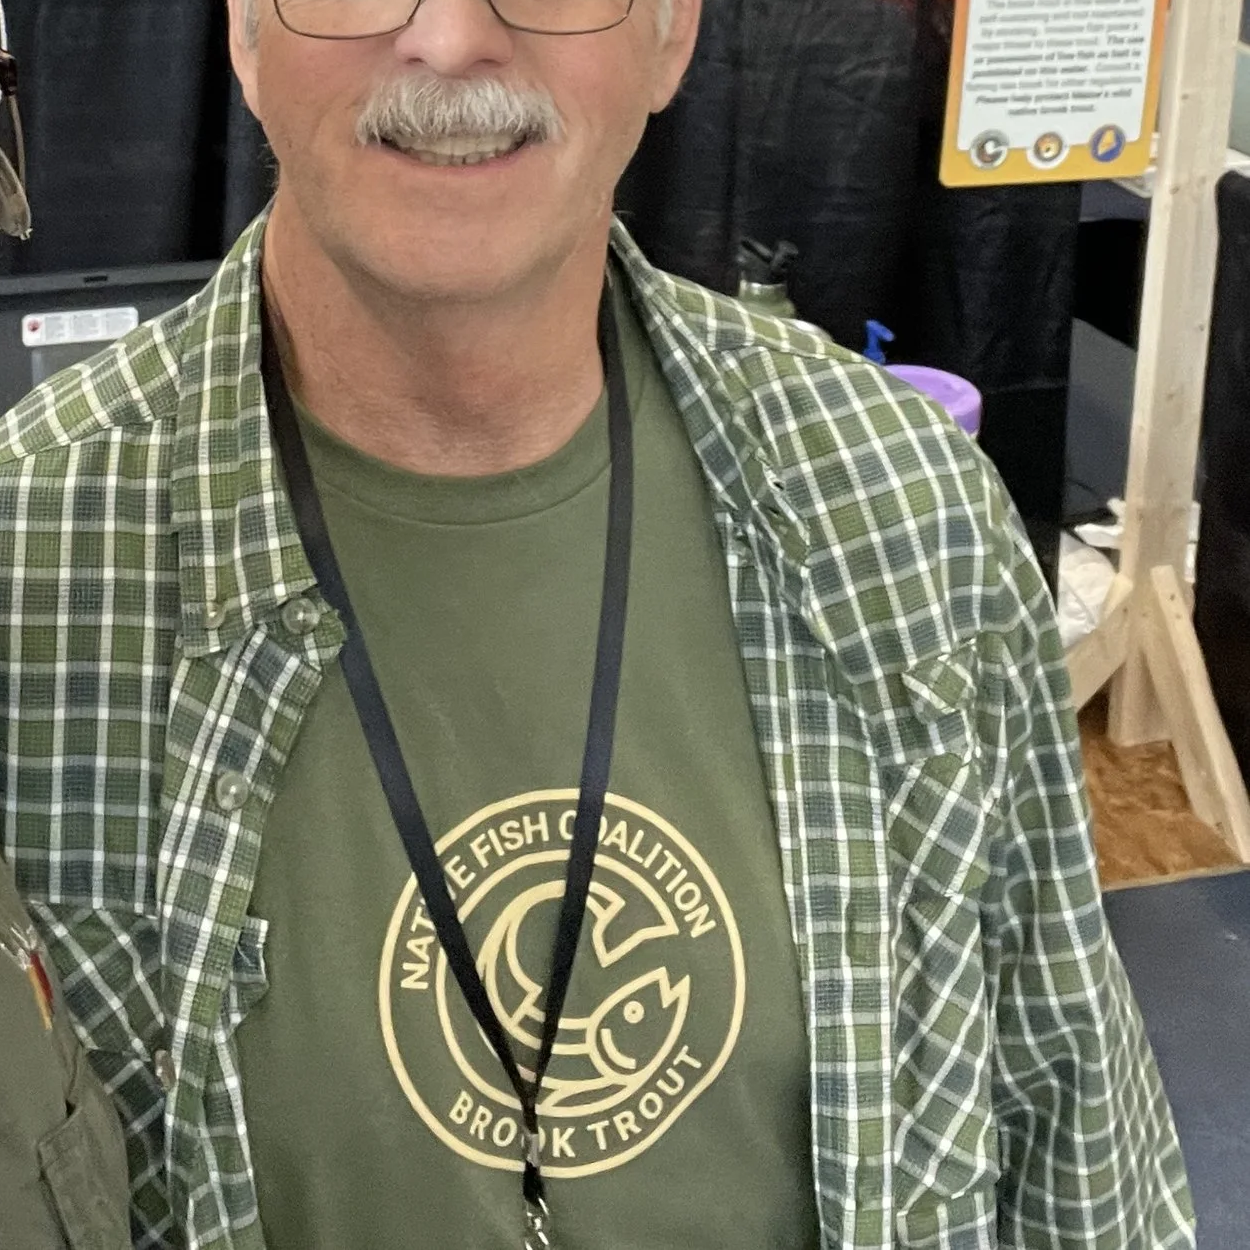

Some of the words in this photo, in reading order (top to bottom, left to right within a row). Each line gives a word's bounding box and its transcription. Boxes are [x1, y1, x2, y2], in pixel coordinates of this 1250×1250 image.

[401, 855, 475, 989] NATE
[469, 811, 549, 868] FISH
[558, 809, 716, 938] CALITION
[586, 1045, 702, 1150] TROUT
